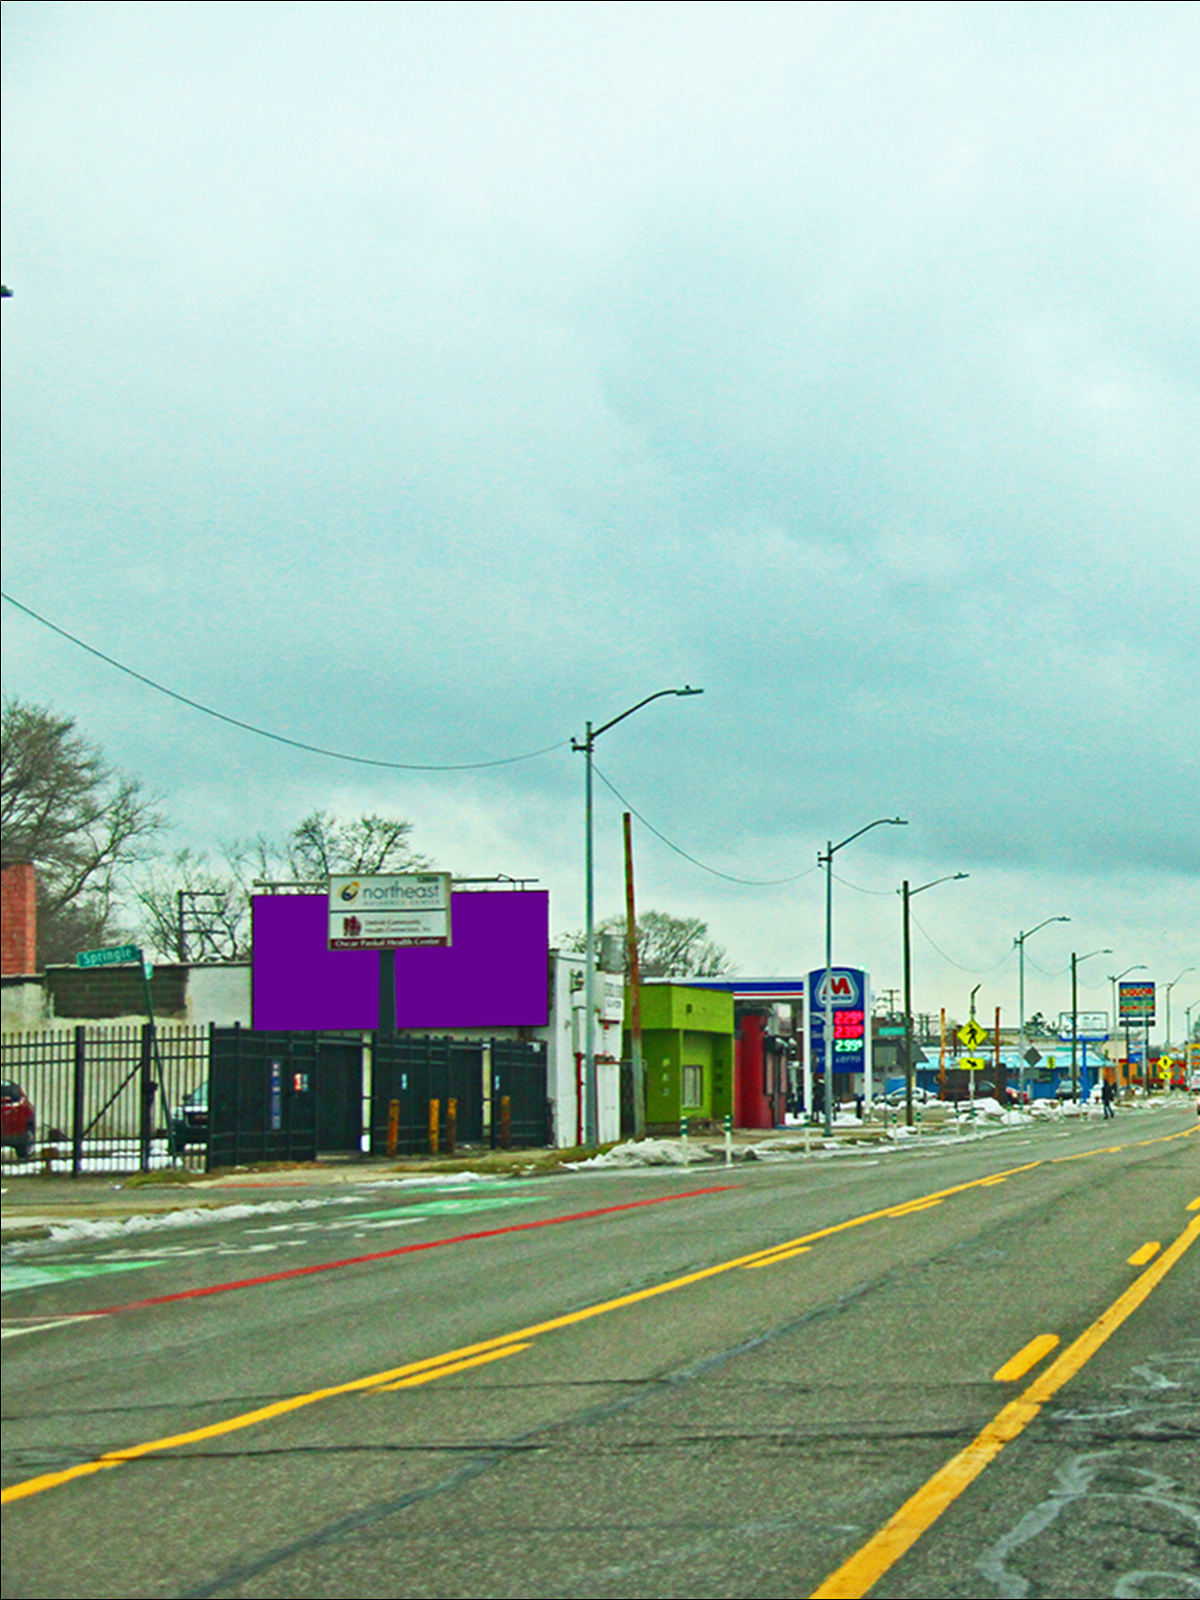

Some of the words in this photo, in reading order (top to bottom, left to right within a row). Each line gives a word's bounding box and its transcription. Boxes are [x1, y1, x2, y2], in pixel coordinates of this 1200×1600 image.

[363, 881, 440, 899] northeast
[414, 937, 440, 945] Center
[83, 947, 133, 967] Springle
[1121, 988, 1154, 997] LIQUOR
